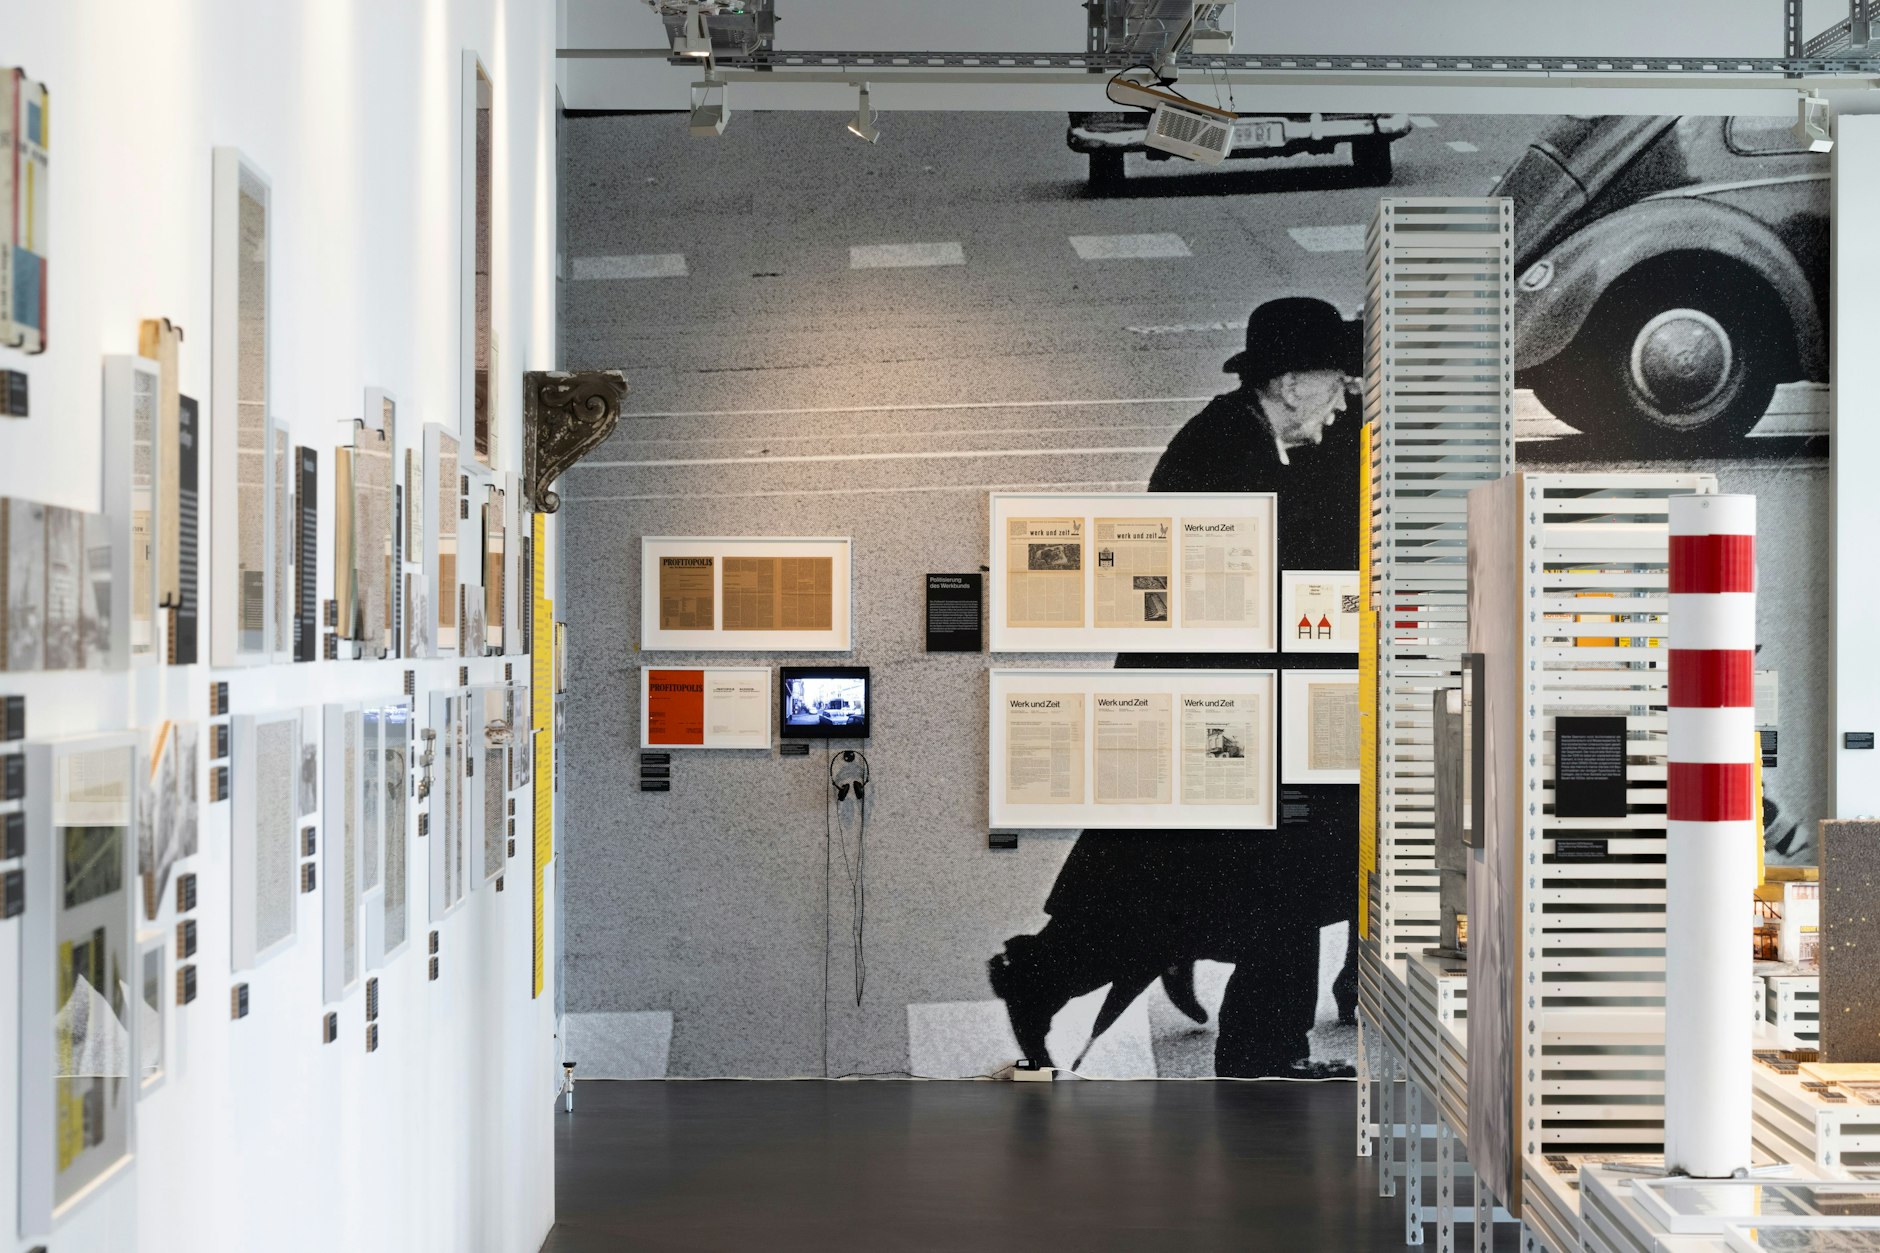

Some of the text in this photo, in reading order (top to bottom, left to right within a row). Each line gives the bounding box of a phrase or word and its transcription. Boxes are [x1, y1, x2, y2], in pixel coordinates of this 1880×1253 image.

[1184, 523, 1235, 532] Werk und Zeit
[1009, 700, 1061, 708] Werk und Zeit
[1098, 698, 1149, 707] Werk und Zeit
[1184, 699, 1235, 708] Werk und Zeit
